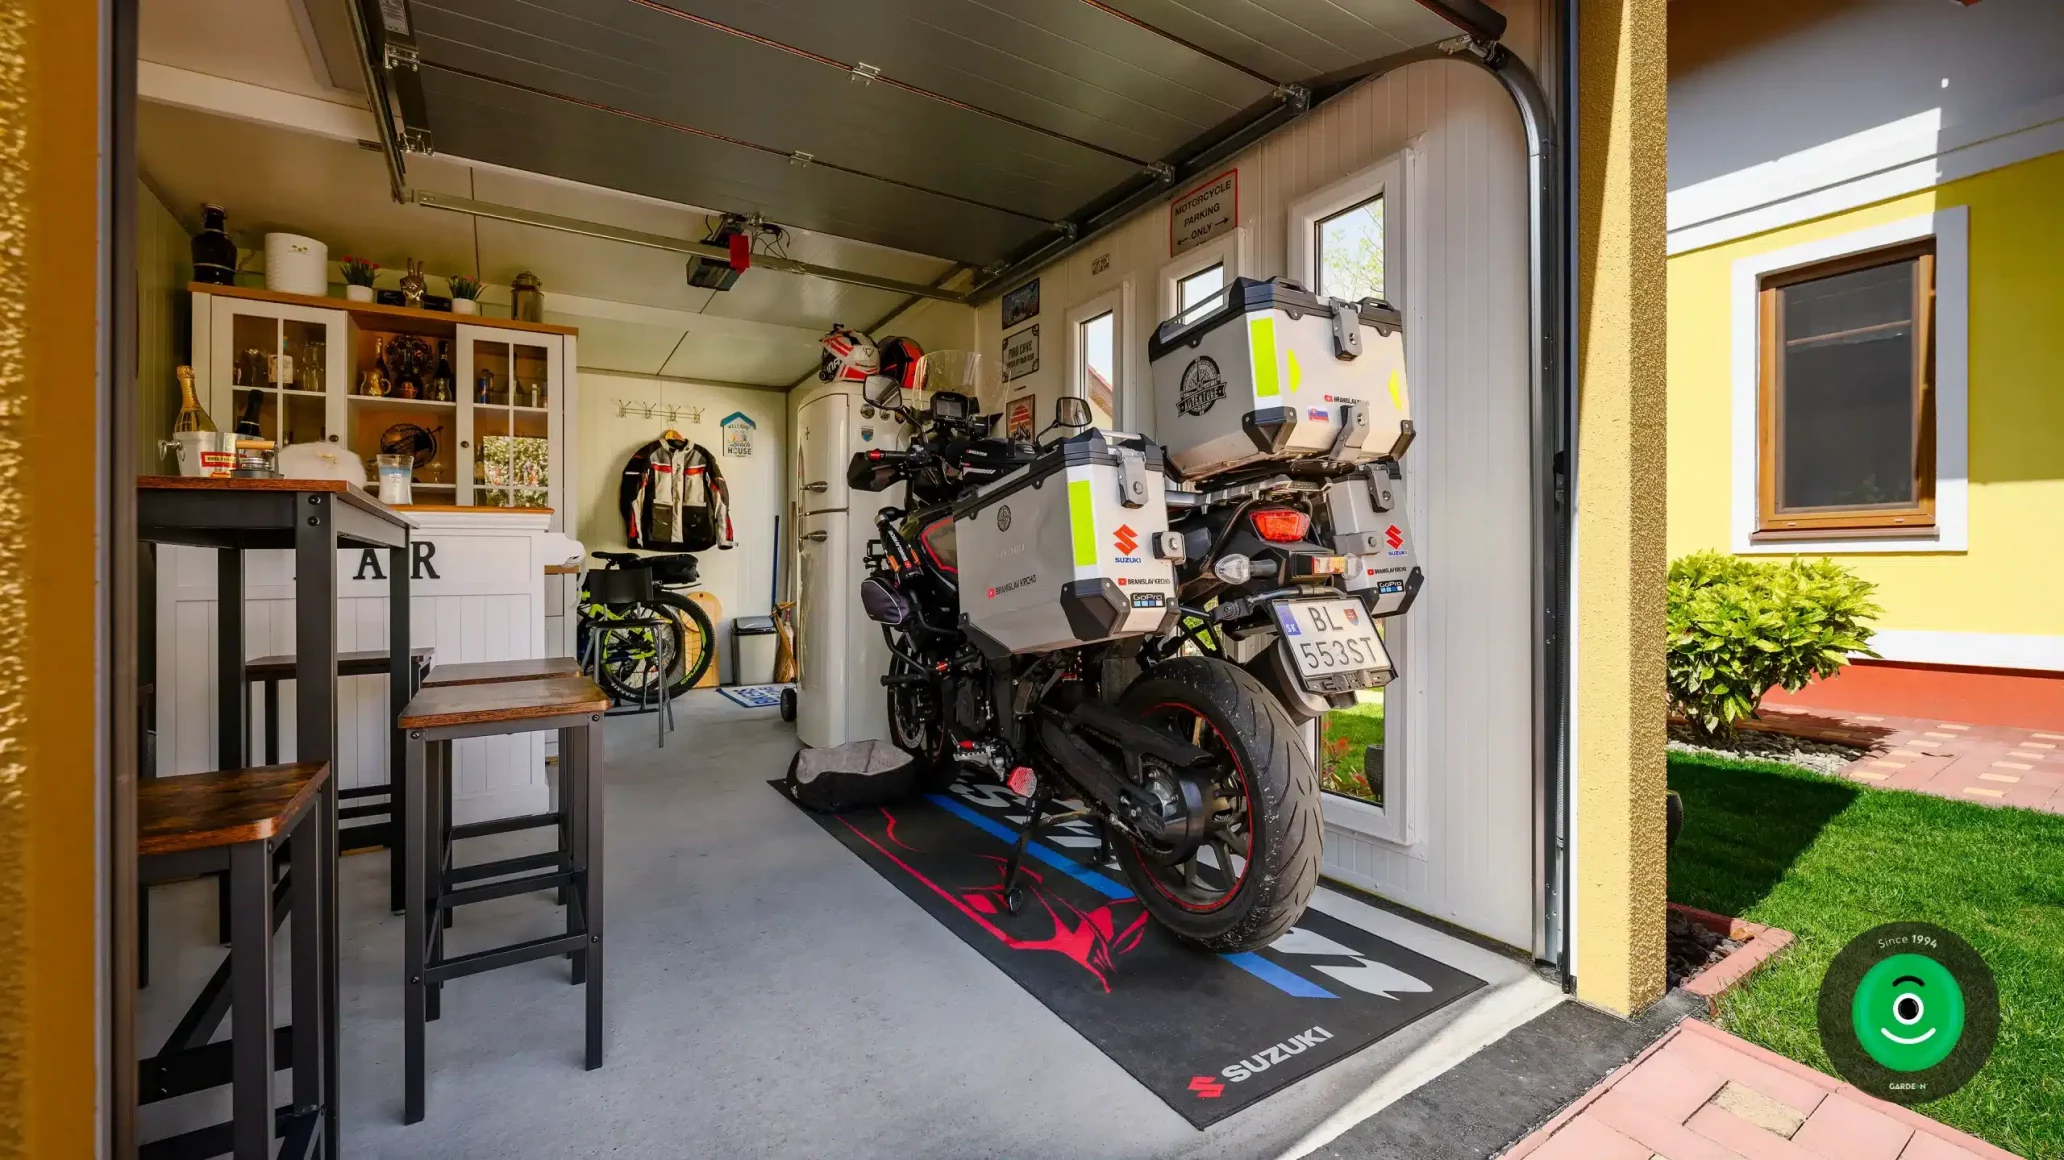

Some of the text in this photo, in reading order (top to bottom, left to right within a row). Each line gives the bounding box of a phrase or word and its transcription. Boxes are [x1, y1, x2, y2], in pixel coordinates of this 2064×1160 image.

[1175, 179, 1232, 216] MOTORCYCLE
[1184, 203, 1220, 228] PARKING
[1191, 222, 1212, 240] ONLY
[727, 446, 752, 456] HOUSE
[1132, 593, 1163, 601] GoPro
[1286, 623, 1297, 633] SK
[1308, 606, 1344, 632] BL
[1299, 636, 1377, 669] 553ST
[1221, 1025, 1335, 1083] SUZUKI
